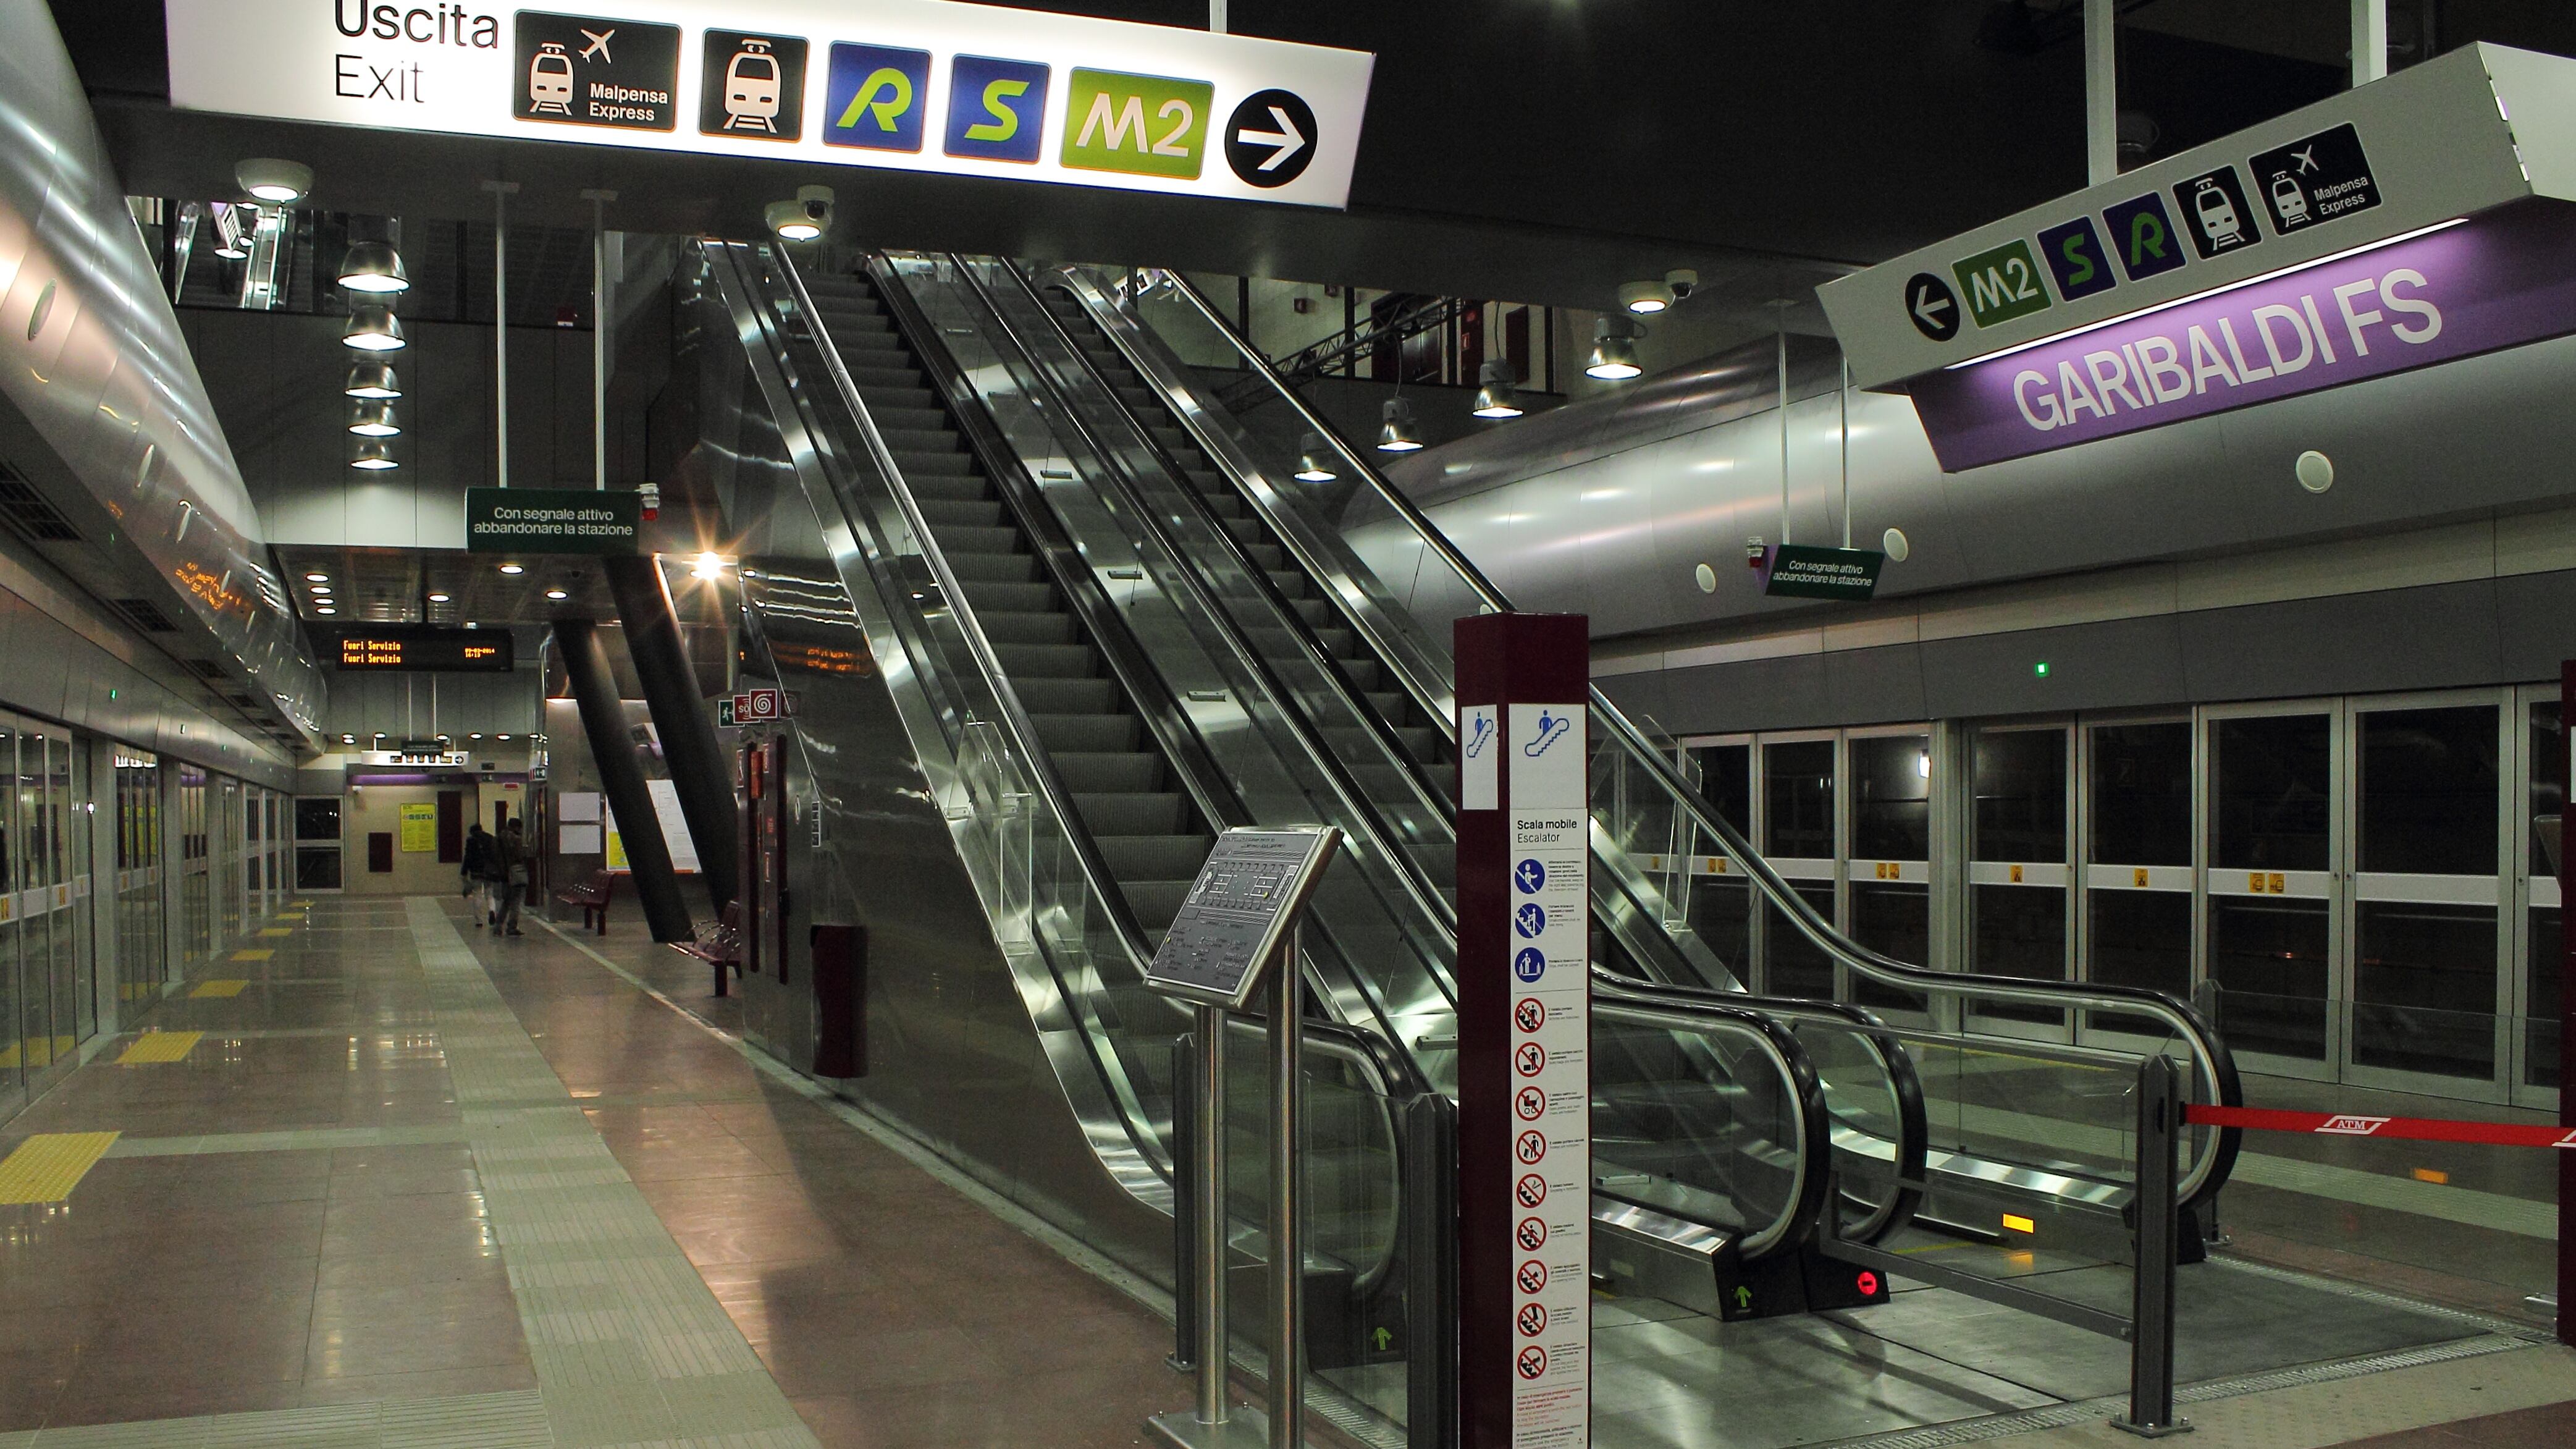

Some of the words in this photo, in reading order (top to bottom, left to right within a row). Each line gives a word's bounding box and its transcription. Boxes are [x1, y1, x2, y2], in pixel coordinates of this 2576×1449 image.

[334, 0, 499, 49] Uscita
[335, 54, 424, 104] Exit
[589, 83, 668, 105] Malpensa
[836, 67, 913, 132] R
[589, 101, 655, 122] Express
[964, 79, 1030, 142] S
[1075, 93, 1193, 158] M2
[2313, 175, 2370, 205] Malpensa
[2318, 191, 2367, 217] Express
[1975, 258, 2039, 313] M2
[2013, 294, 2336, 431] GARIBALDI
[2333, 269, 2444, 358] FS
[494, 507, 521, 520] Con
[523, 509, 575, 522] segnale
[577, 509, 614, 522] attivo
[474, 522, 562, 534] abbandonare
[564, 523, 575, 535] la
[578, 523, 633, 536] stazione
[1789, 560, 1806, 570] Con
[1807, 562, 1839, 572] segnale
[1840, 564, 1863, 574] attivo
[1773, 572, 1828, 583] abbandonare
[1829, 574, 1835, 584] la
[1837, 575, 1872, 586] stazione
[343, 640, 364, 651] Fuori
[368, 640, 401, 651] Servizio
[343, 653, 364, 663] Fuori
[368, 653, 401, 663] Servizio
[738, 705, 750, 713] SO
[1517, 819, 1544, 830] Scala
[1546, 819, 1577, 829] mobile
[1517, 833, 1560, 843] Escalator
[2337, 1120, 2366, 1130] ATM
